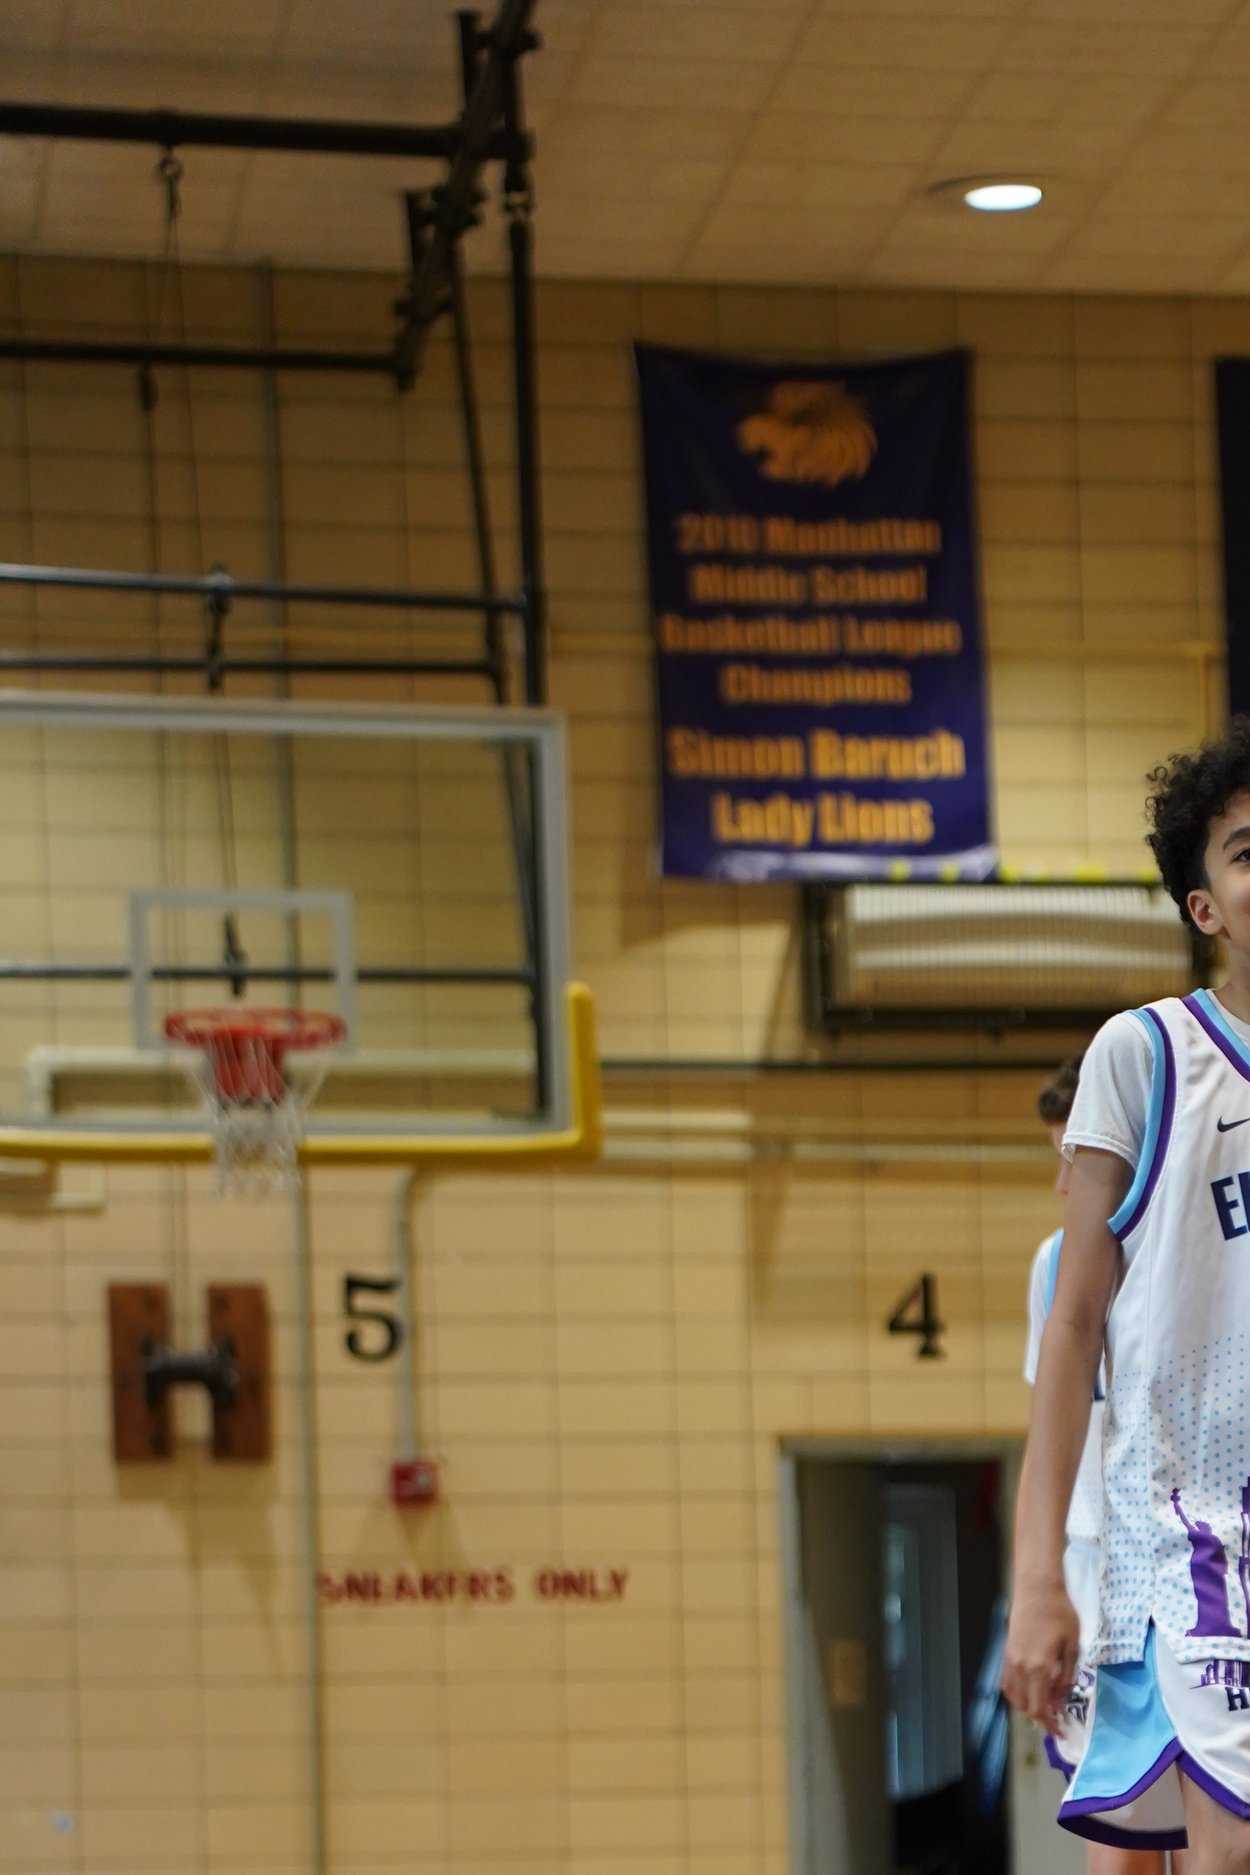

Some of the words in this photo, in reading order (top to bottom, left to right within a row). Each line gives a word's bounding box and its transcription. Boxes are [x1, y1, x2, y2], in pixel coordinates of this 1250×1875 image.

[763, 517, 942, 555] Manhattan
[690, 565, 806, 603] Middle
[811, 565, 927, 604] School
[660, 614, 839, 653] Basketball
[843, 617, 960, 658] League
[720, 664, 911, 705] Champions
[670, 727, 804, 777] Simon
[810, 727, 965, 780] Baruch
[711, 793, 814, 846] Lady
[819, 794, 934, 844] Lions
[343, 1273, 401, 1361] 5
[887, 1272, 946, 1359] 4
[536, 1566, 629, 1602] ONLY
